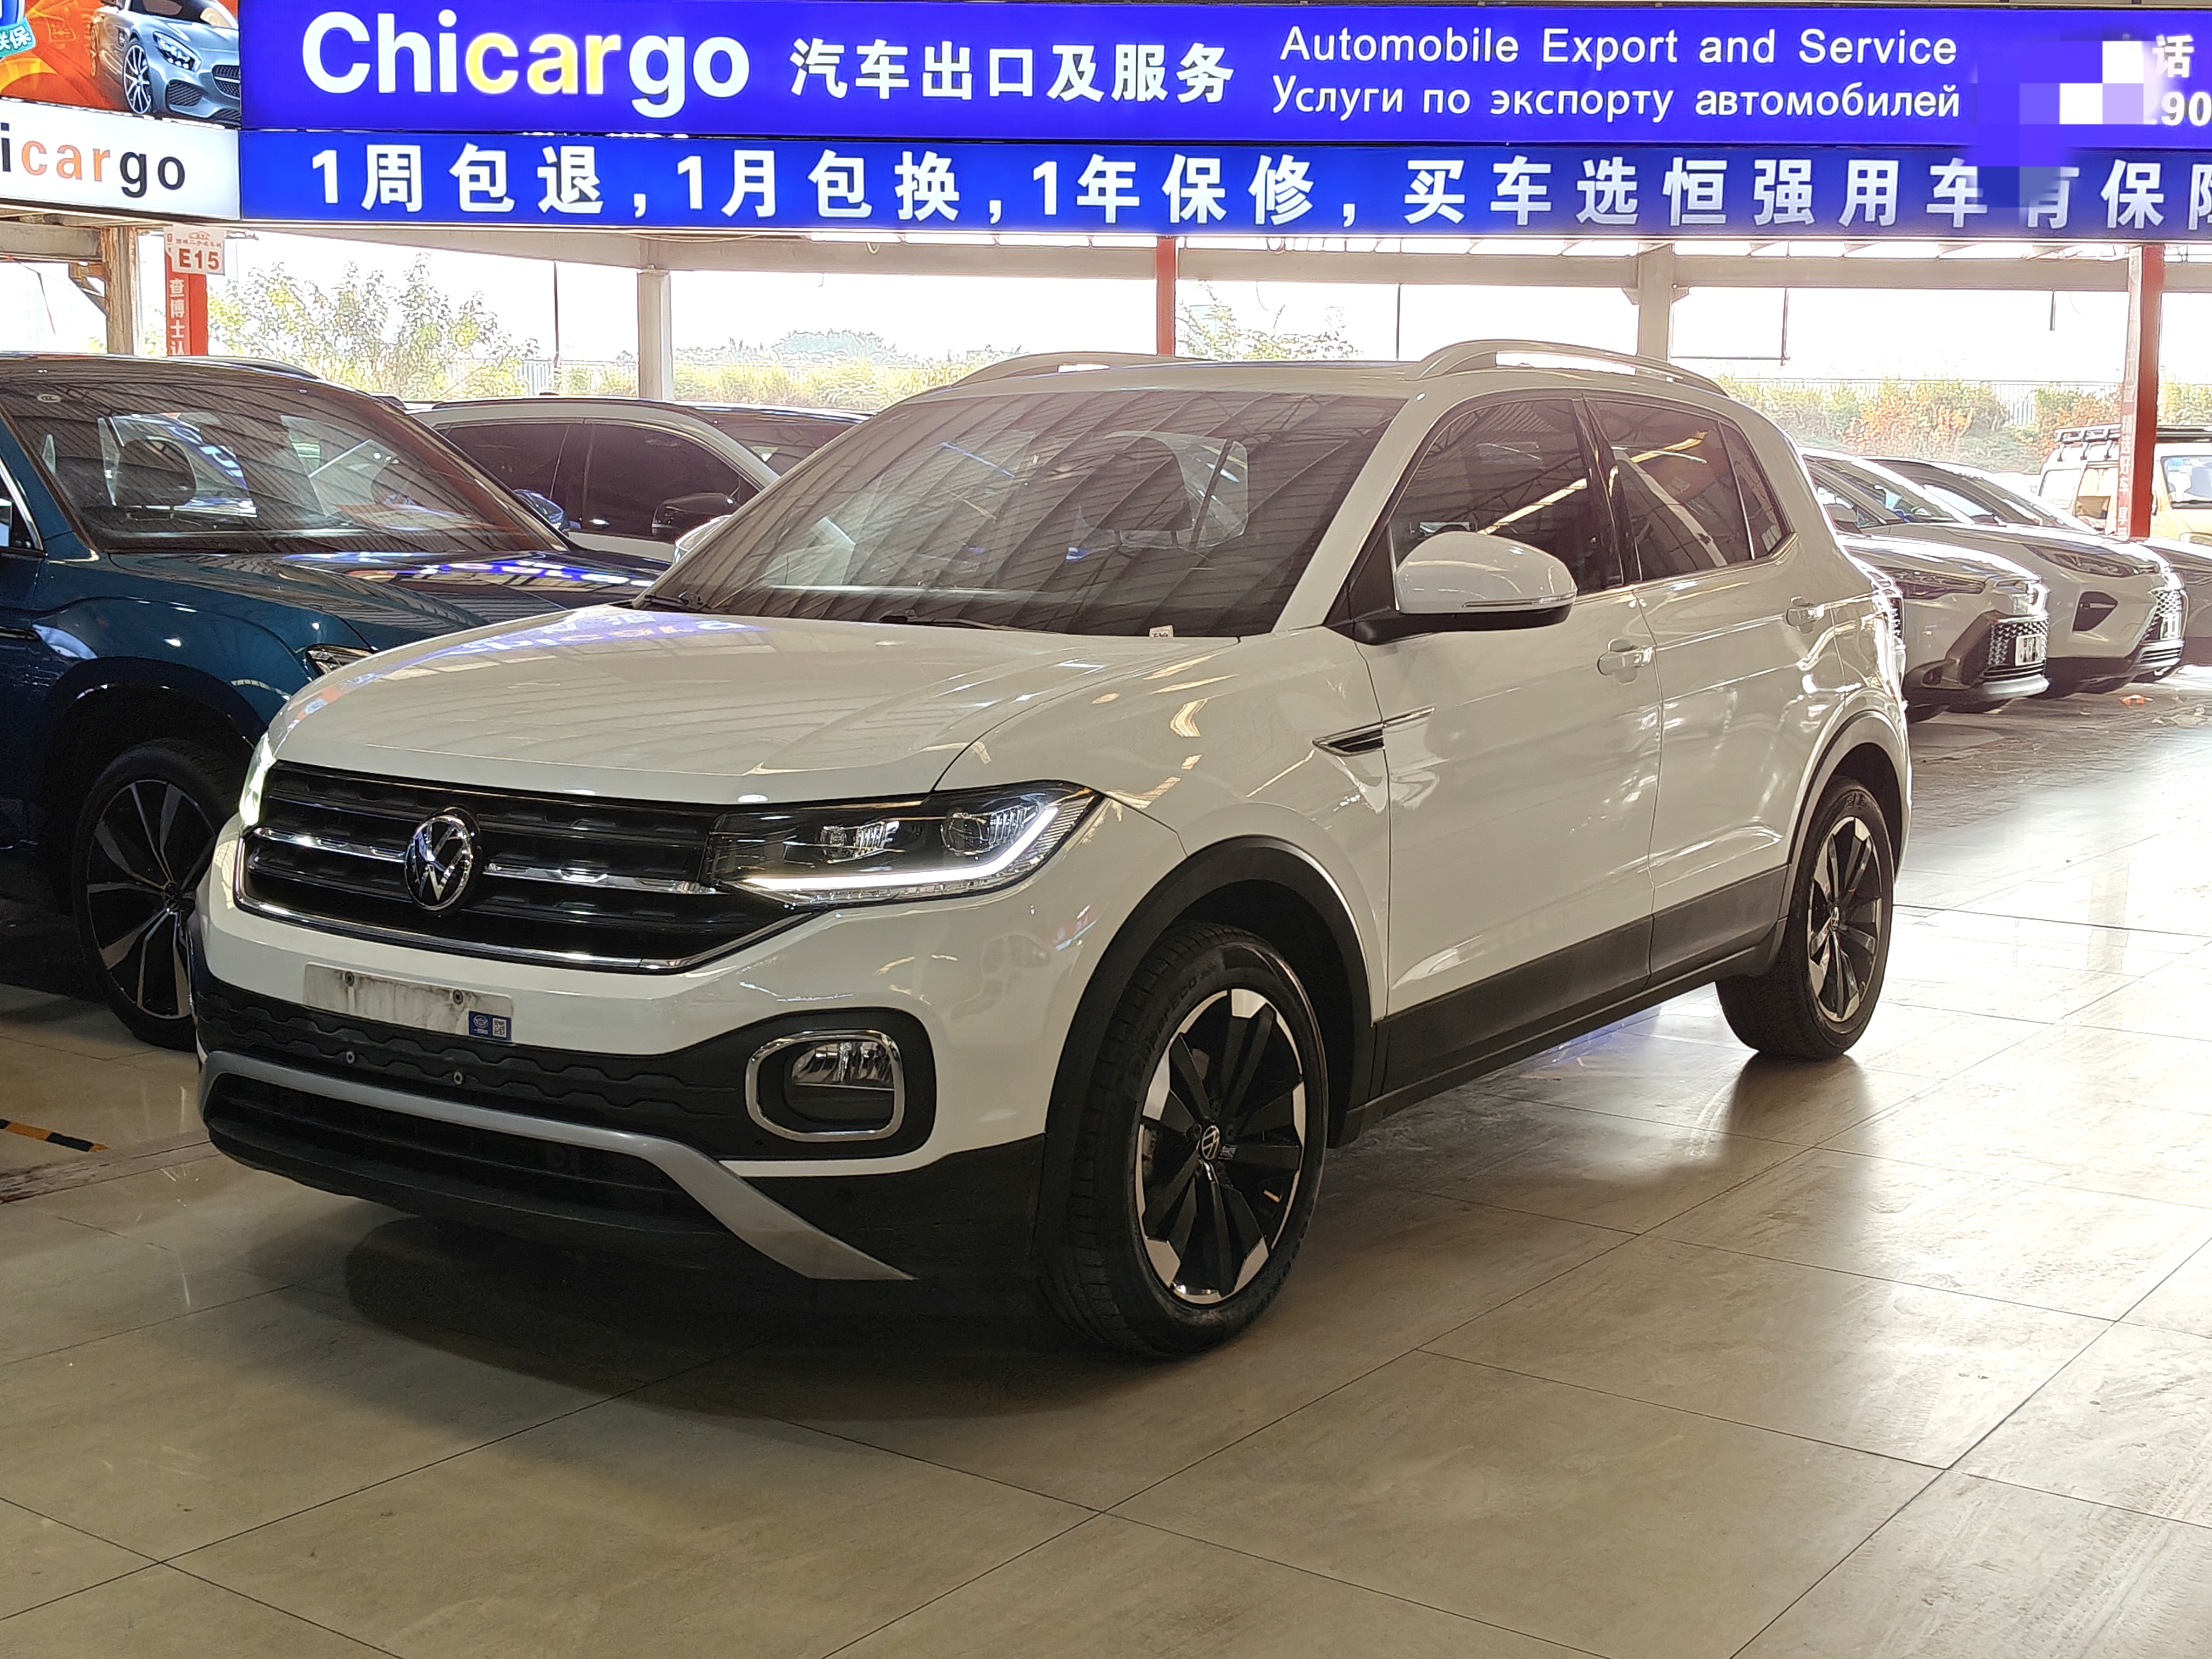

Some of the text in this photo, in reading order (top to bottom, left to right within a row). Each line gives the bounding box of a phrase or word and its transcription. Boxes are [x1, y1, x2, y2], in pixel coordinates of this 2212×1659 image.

[302, 9, 750, 118] Chicargo
[790, 38, 1235, 103] 汽车出口及服务
[1280, 26, 1957, 71] Automobile Export and Service
[1272, 75, 1960, 123] Услуги по экспорту автомобилей
[179, 248, 219, 270] E15
